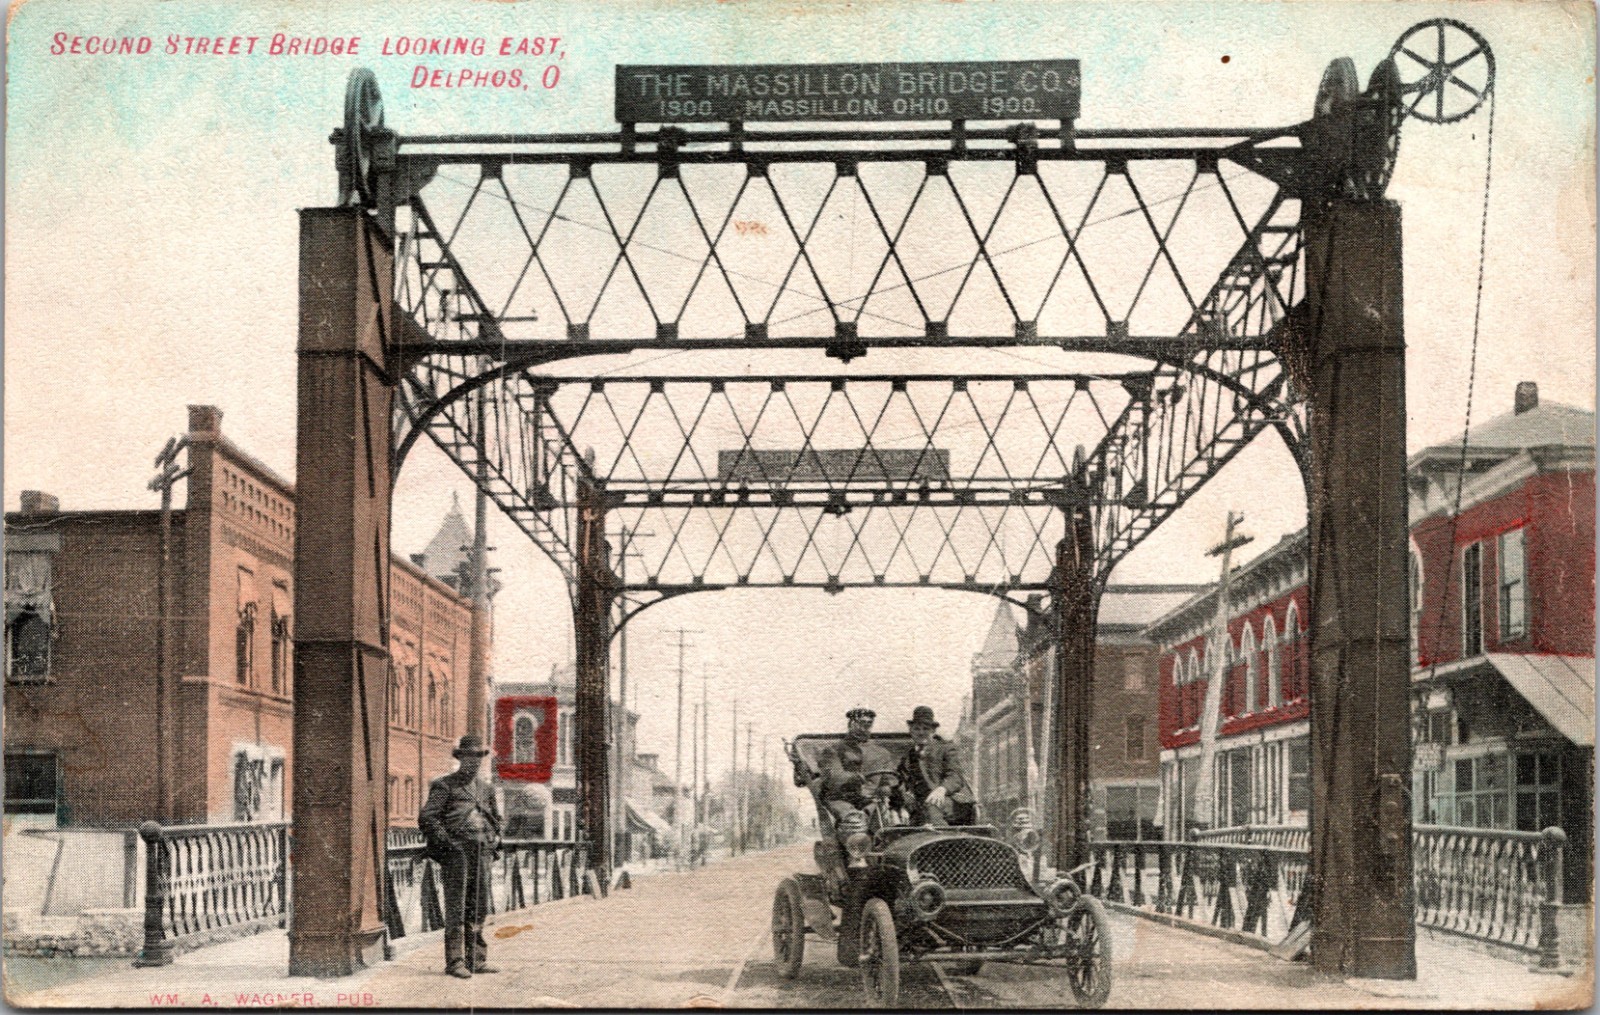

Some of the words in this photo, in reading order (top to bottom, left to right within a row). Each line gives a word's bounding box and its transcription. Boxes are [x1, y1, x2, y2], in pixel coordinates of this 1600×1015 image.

[634, 74, 692, 96] THE
[707, 72, 881, 96] MASSILLON
[898, 71, 1008, 94] BRIDGE
